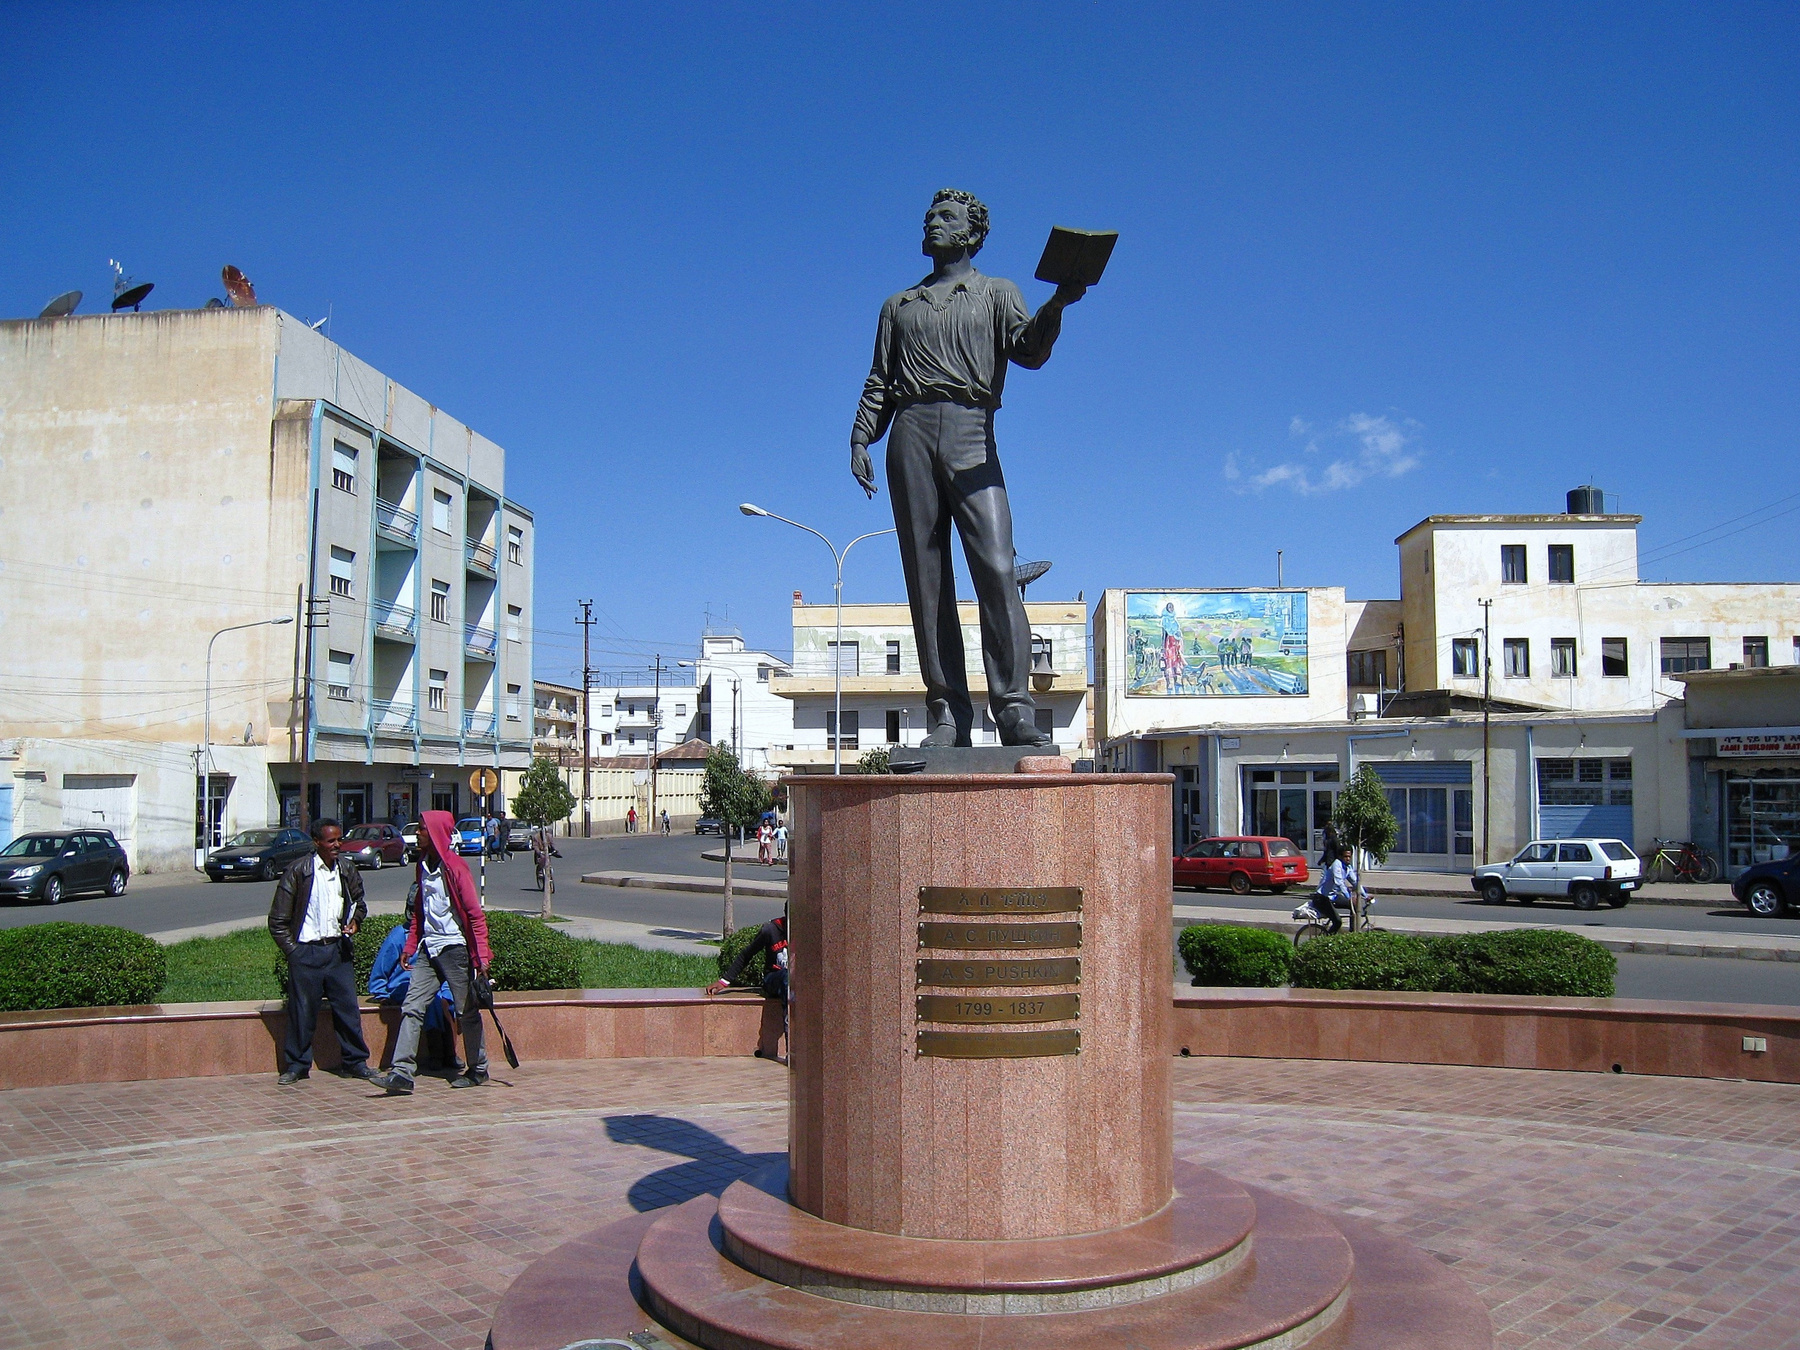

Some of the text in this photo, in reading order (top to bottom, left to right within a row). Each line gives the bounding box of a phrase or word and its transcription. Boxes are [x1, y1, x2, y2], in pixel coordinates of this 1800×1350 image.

[1743, 743, 1780, 751] BUILDING
[987, 928, 1061, 943] ПУШКИН
[985, 965, 1060, 980] PUSHKIN
[955, 1002, 992, 1016] 1799
[1009, 1001, 1045, 1015] 1837
